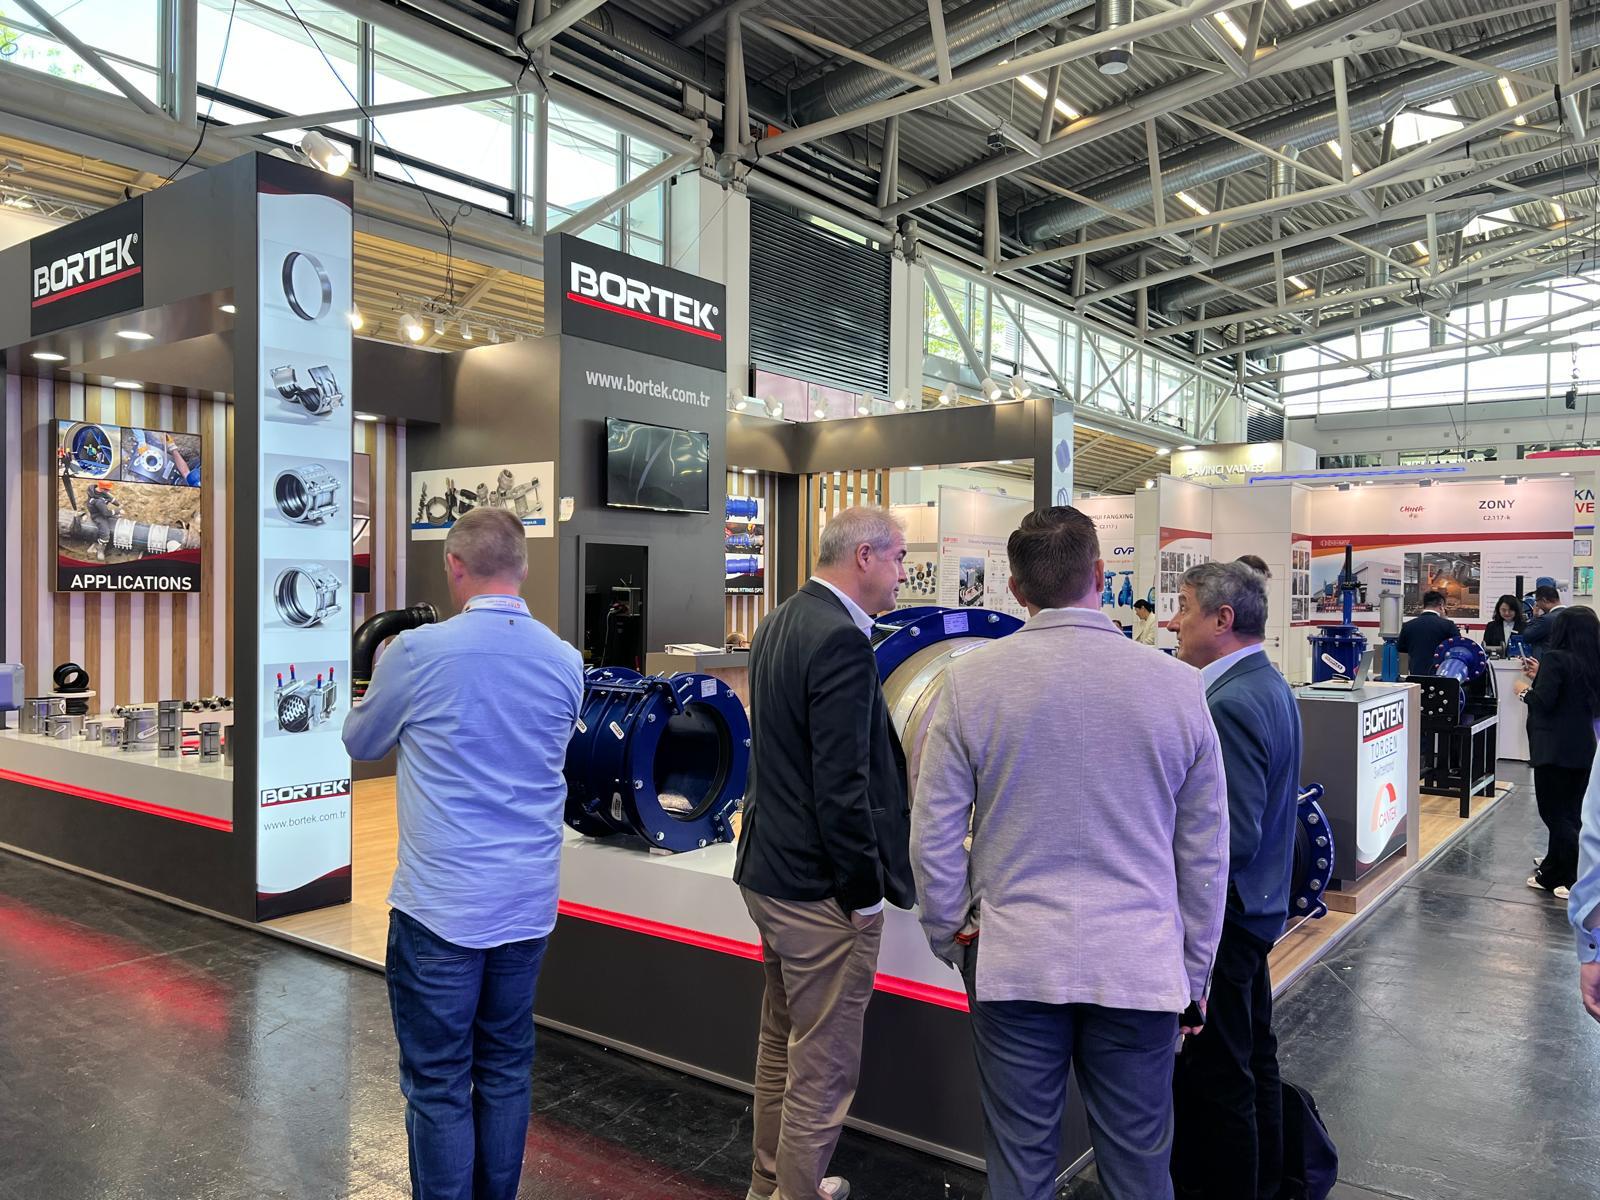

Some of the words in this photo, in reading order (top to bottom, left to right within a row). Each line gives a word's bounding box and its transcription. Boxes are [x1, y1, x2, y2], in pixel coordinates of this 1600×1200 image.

[586, 370, 711, 408] www.bortek.com.tr
[1479, 499, 1515, 510] ZONY
[71, 574, 192, 590] APPLICATIONS
[1363, 701, 1403, 737] BORTEK
[1371, 735, 1398, 760] TORGEN
[264, 811, 346, 831] www.bortek.com.tr
